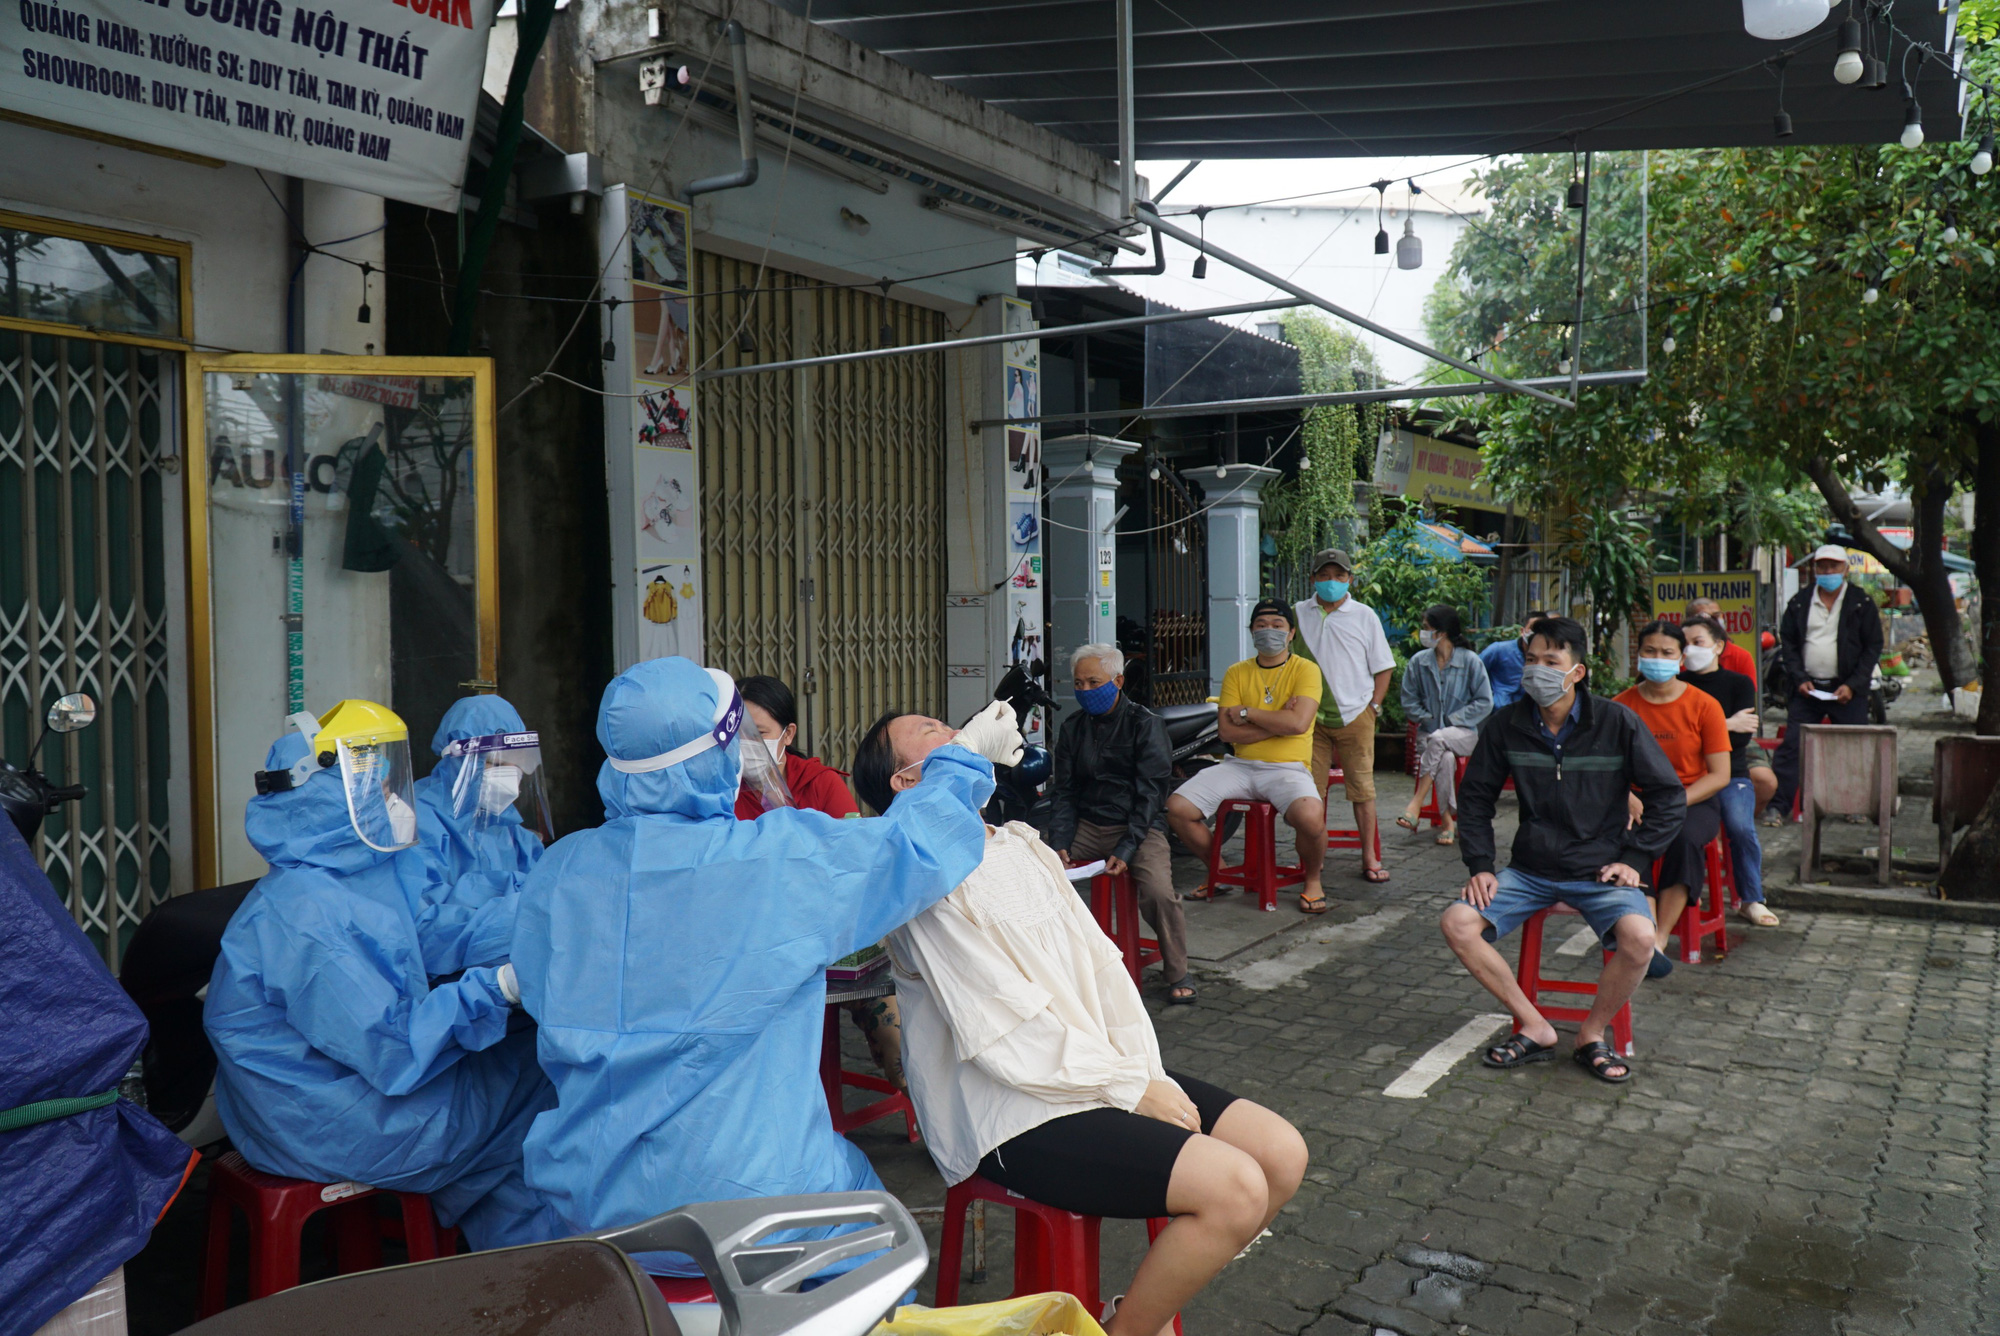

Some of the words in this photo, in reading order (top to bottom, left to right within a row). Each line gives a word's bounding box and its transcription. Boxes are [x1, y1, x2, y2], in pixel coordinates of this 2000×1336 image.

[291, 7, 348, 59] NỘI
[358, 26, 429, 80] THẤT
[20, 0, 90, 44] QUẢNG
[97, 19, 145, 57] NAM:
[149, 33, 212, 74] XƯỞNG
[217, 51, 244, 82] SX:
[249, 59, 283, 91] DUY
[288, 68, 321, 104] TÂN,
[326, 79, 357, 111] TAM
[361, 88, 382, 120] KỲ,
[387, 97, 432, 132] QUẢNG
[436, 111, 464, 140] NAM
[23, 48, 146, 104] SHOWROOM:
[152, 80, 188, 113] DUY
[193, 88, 231, 126] TÂN,
[236, 100, 270, 133] TAM
[274, 108, 298, 142] KỲ,
[303, 117, 354, 153] QUẢNG
[358, 131, 391, 162] NAM
[1100, 550, 1112, 565] 123
[1702, 581, 1751, 599] THANH
[1723, 604, 1753, 633] HỜ
